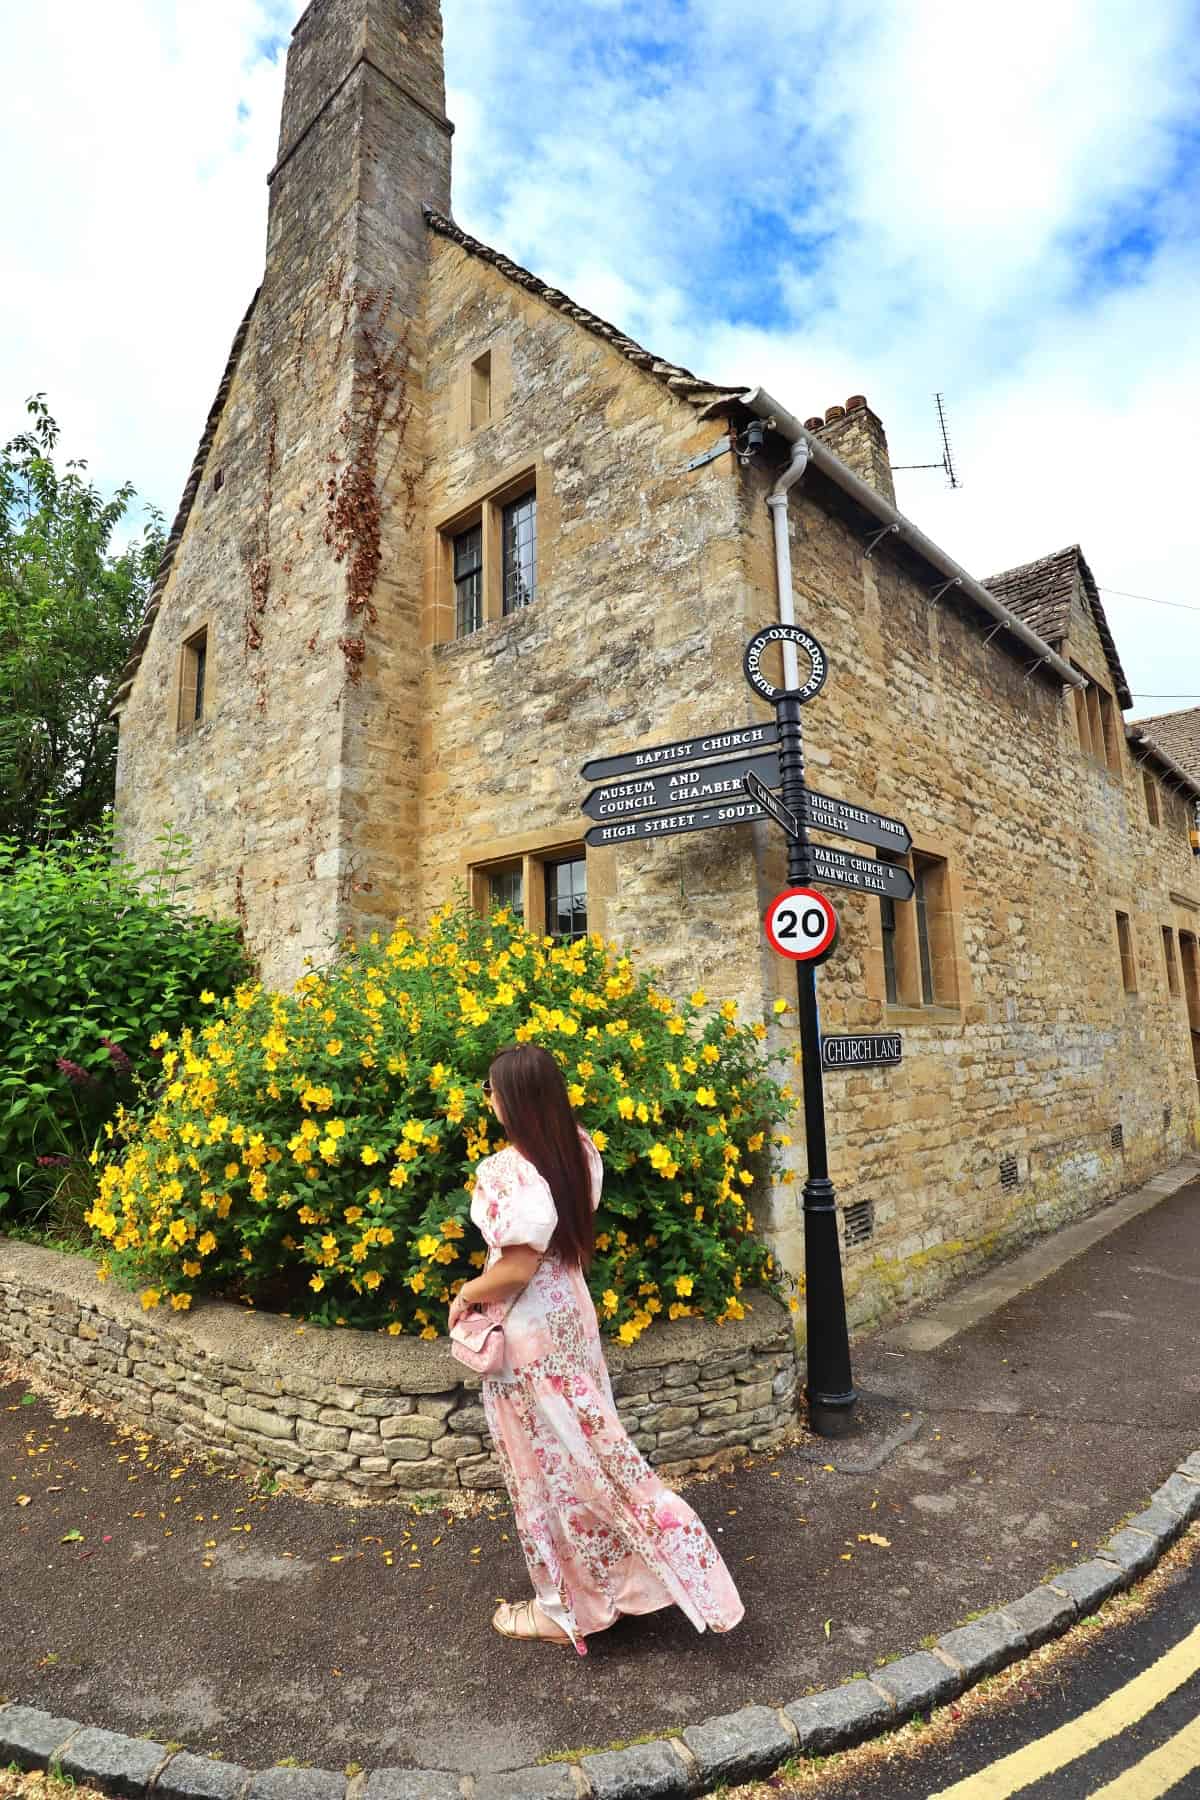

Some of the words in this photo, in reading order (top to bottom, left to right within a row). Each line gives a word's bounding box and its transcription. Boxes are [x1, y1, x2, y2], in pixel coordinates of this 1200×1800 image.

[636, 744, 693, 766] BAPTIST
[702, 729, 763, 751] CHURCH
[599, 781, 655, 801] MUSEUM
[669, 772, 700, 787] AND
[599, 795, 656, 814] COUNCIL
[670, 776, 745, 801] CHAMBER
[602, 824, 637, 839] HIGH
[644, 814, 695, 832] STREET
[811, 795, 835, 813] HIGH
[840, 805, 869, 824] STREET
[880, 818, 905, 836] NORTH
[812, 811, 849, 831] TOILETS
[814, 848, 846, 866] PARISH
[850, 858, 883, 876] CHURCH
[815, 864, 860, 885] WARWICK
[864, 875, 887, 890] HALL
[777, 908, 825, 939] 20
[827, 1040, 872, 1062] CHURCH
[874, 1038, 899, 1059] LANE
